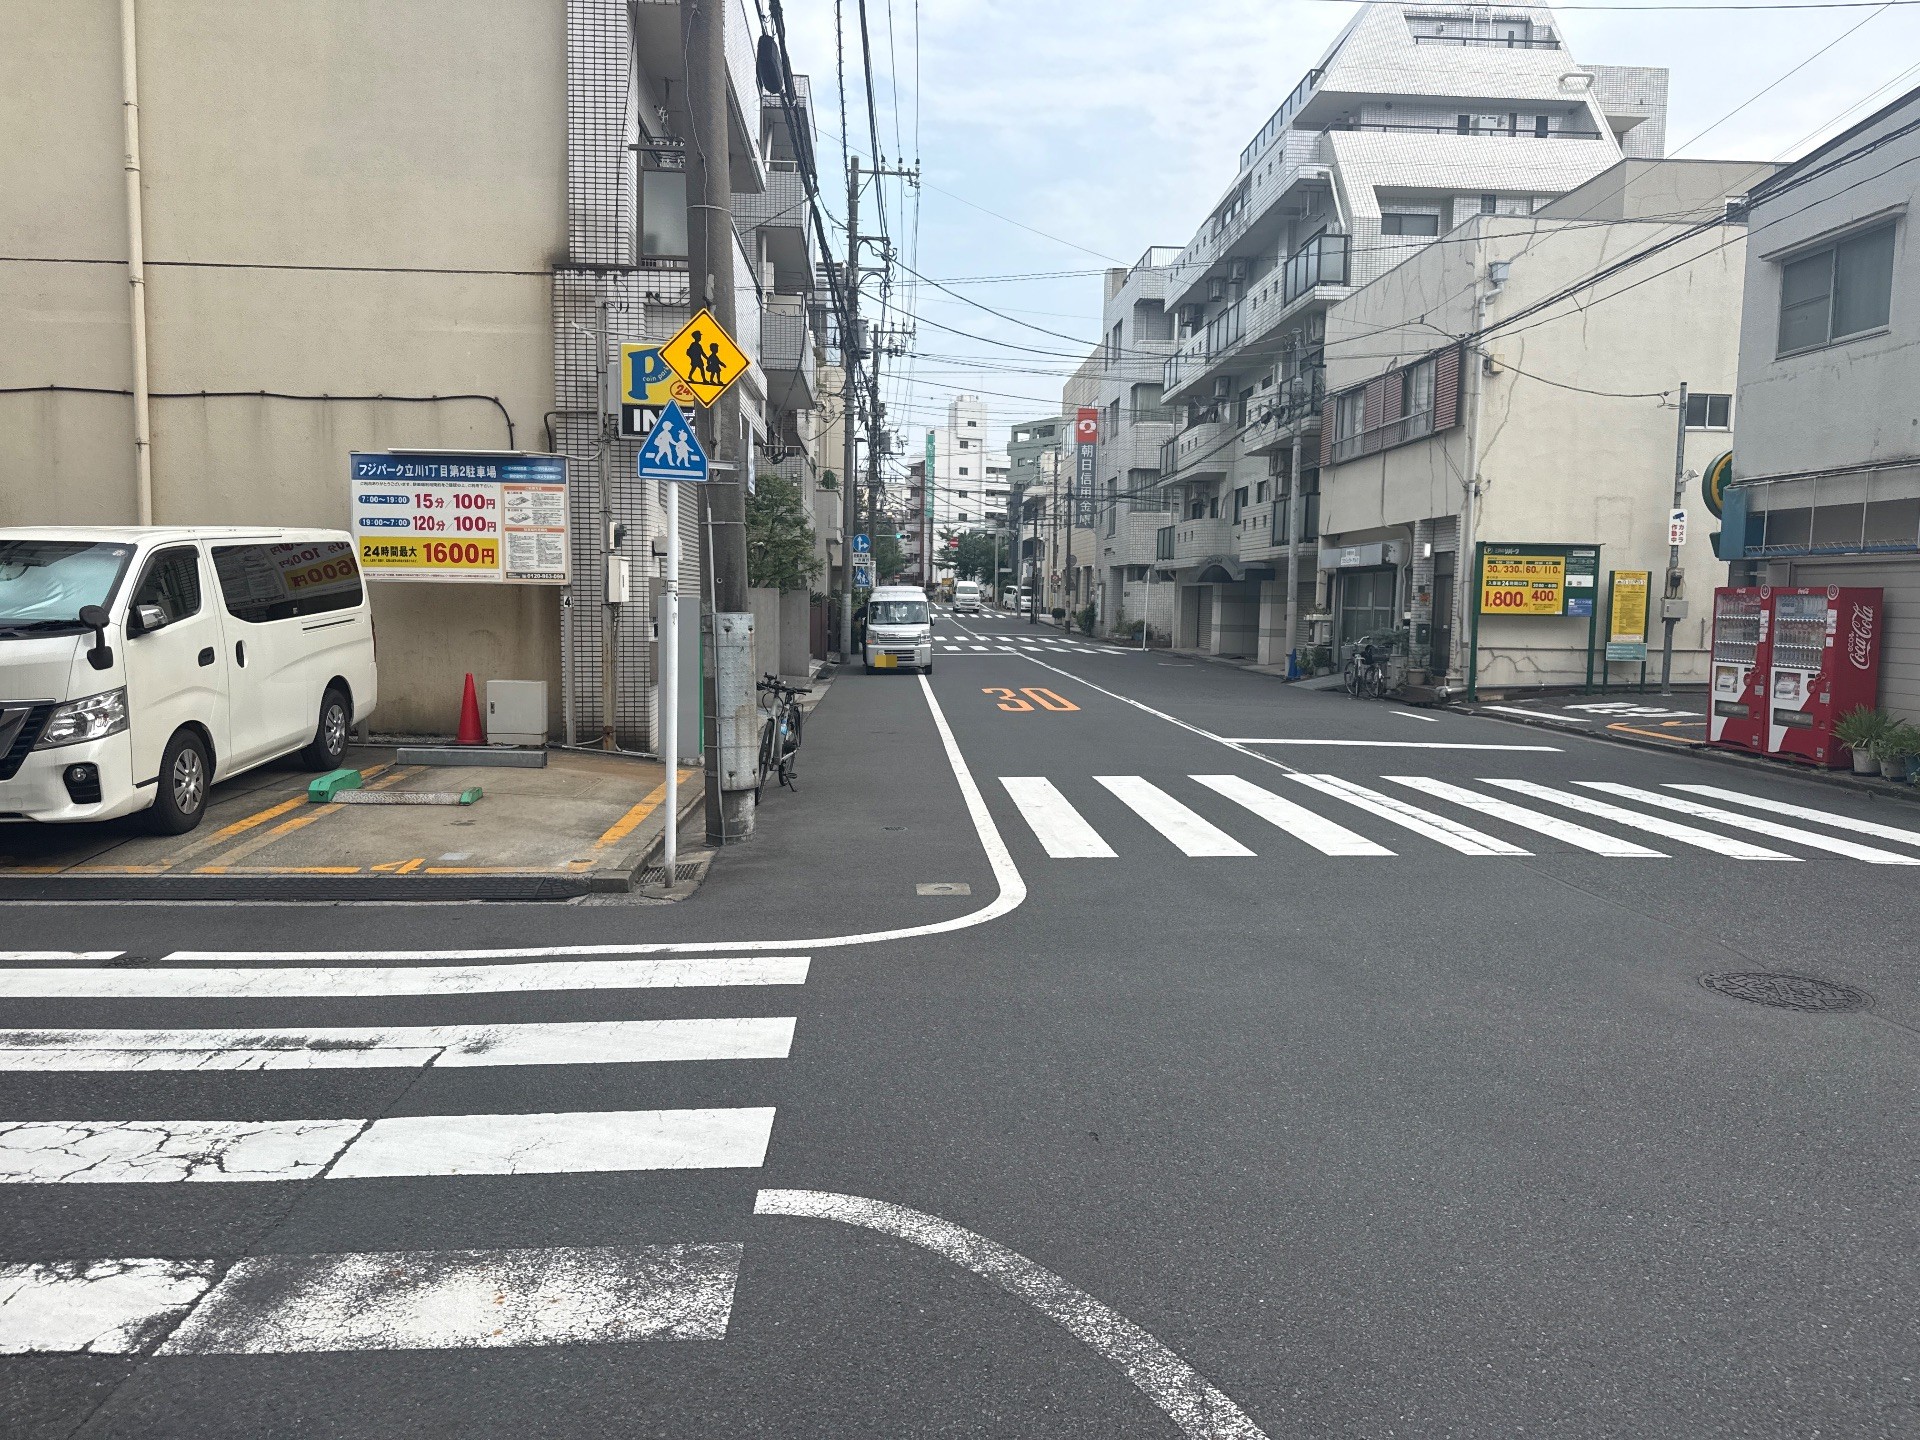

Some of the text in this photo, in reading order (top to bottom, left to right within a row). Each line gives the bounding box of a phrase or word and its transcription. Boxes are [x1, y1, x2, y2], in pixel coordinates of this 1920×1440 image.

[675, 384, 693, 396] 24
[359, 463, 497, 478] フジパーク立川1丁目第2駐車場
[363, 545, 418, 557] 24時間最大
[422, 542, 495, 564] 1600円
[564, 596, 571, 608] 4
[1849, 601, 1874, 670] Coca-Cola
[981, 687, 1082, 712] 30
[369, 858, 426, 874] 4
